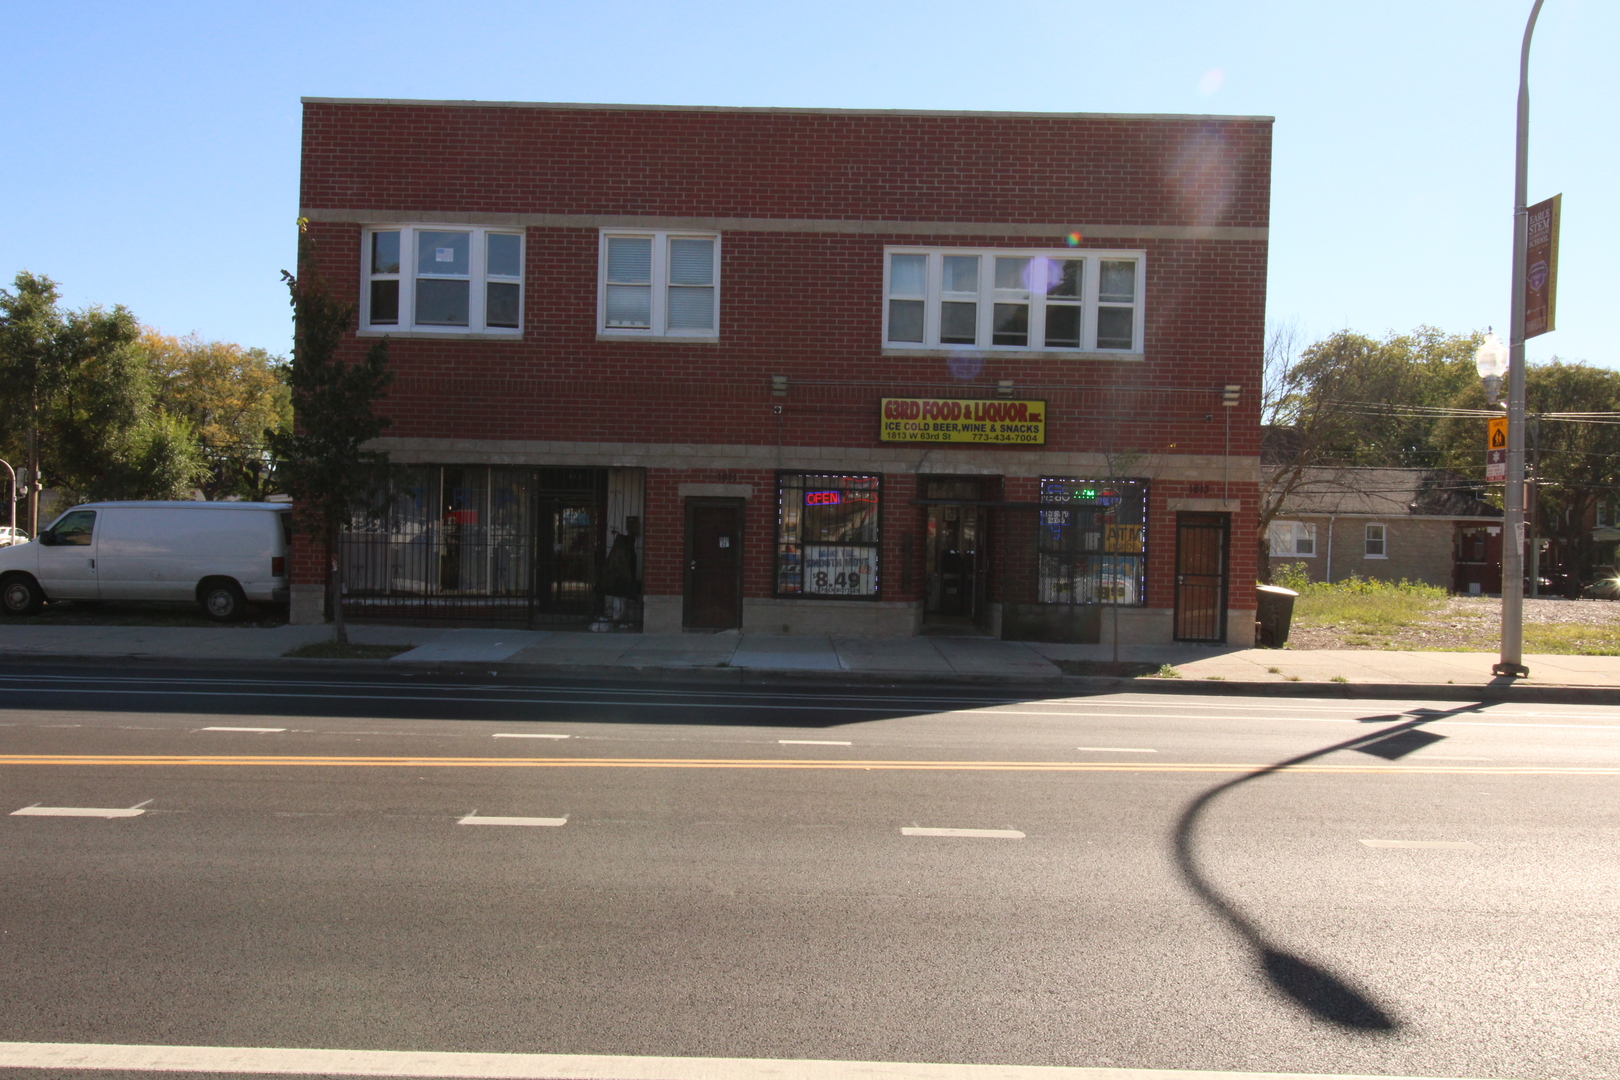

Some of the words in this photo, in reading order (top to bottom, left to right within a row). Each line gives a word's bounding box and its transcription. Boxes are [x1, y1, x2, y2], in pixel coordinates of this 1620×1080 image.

[1530, 208, 1551, 225] EARLE
[1529, 217, 1550, 236] STEM
[1529, 234, 1549, 249] SCHOOL
[885, 400, 920, 420] 63RD
[922, 401, 962, 421] FOOD
[963, 404, 972, 420] &
[974, 402, 1028, 423] LIQUOR
[885, 421, 901, 431] ICE
[904, 422, 930, 431] COLD
[989, 424, 997, 433] &
[1000, 424, 1040, 434] SNACKS
[887, 431, 907, 440] 1813
[909, 432, 918, 440] W
[920, 432, 940, 441] 63rd
[942, 432, 951, 441] St
[972, 433, 1038, 442] 773-434-7004
[1190, 484, 1209, 494] 1813
[807, 492, 838, 504] OPEN
[1107, 527, 1142, 541] ATM
[1110, 542, 1138, 550] INSIDE
[805, 558, 842, 568] SMOOTH
